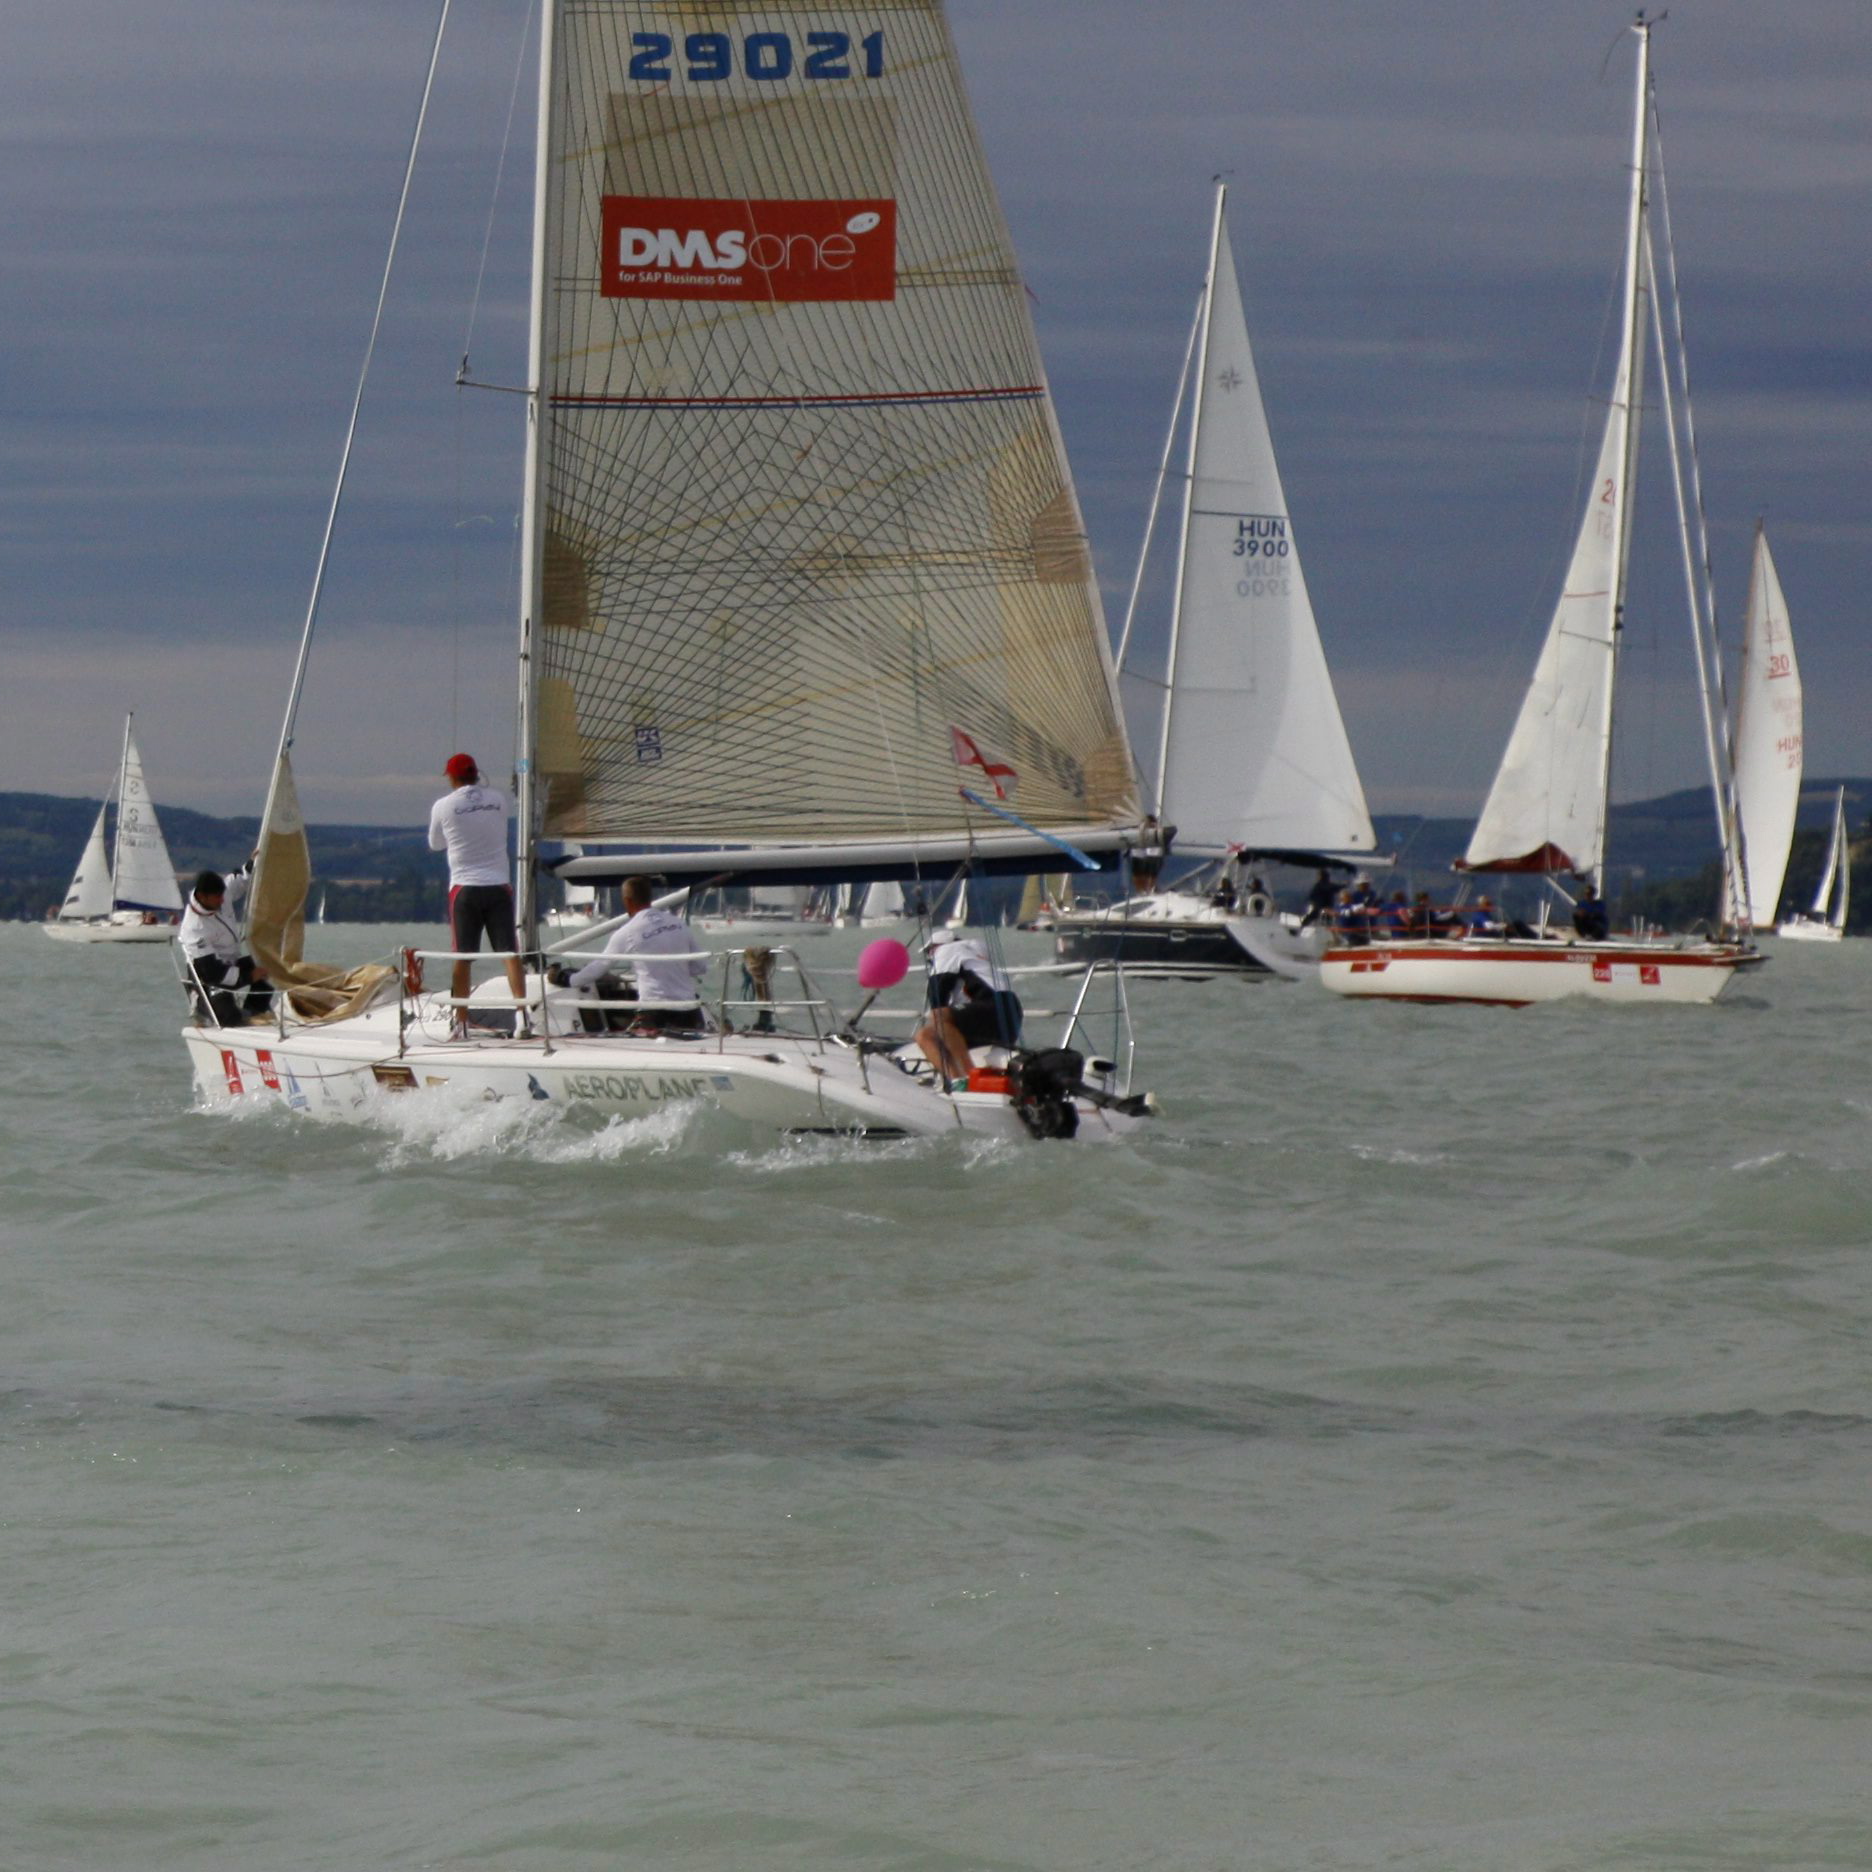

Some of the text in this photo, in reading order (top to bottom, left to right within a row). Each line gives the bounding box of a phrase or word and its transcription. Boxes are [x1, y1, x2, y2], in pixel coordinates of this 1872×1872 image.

[628, 31, 884, 81] 29021
[619, 270, 743, 285] for SAP Business One
[1239, 519, 1285, 537] HUN
[1233, 539, 1289, 557] 3900
[1769, 654, 1790, 673] 30
